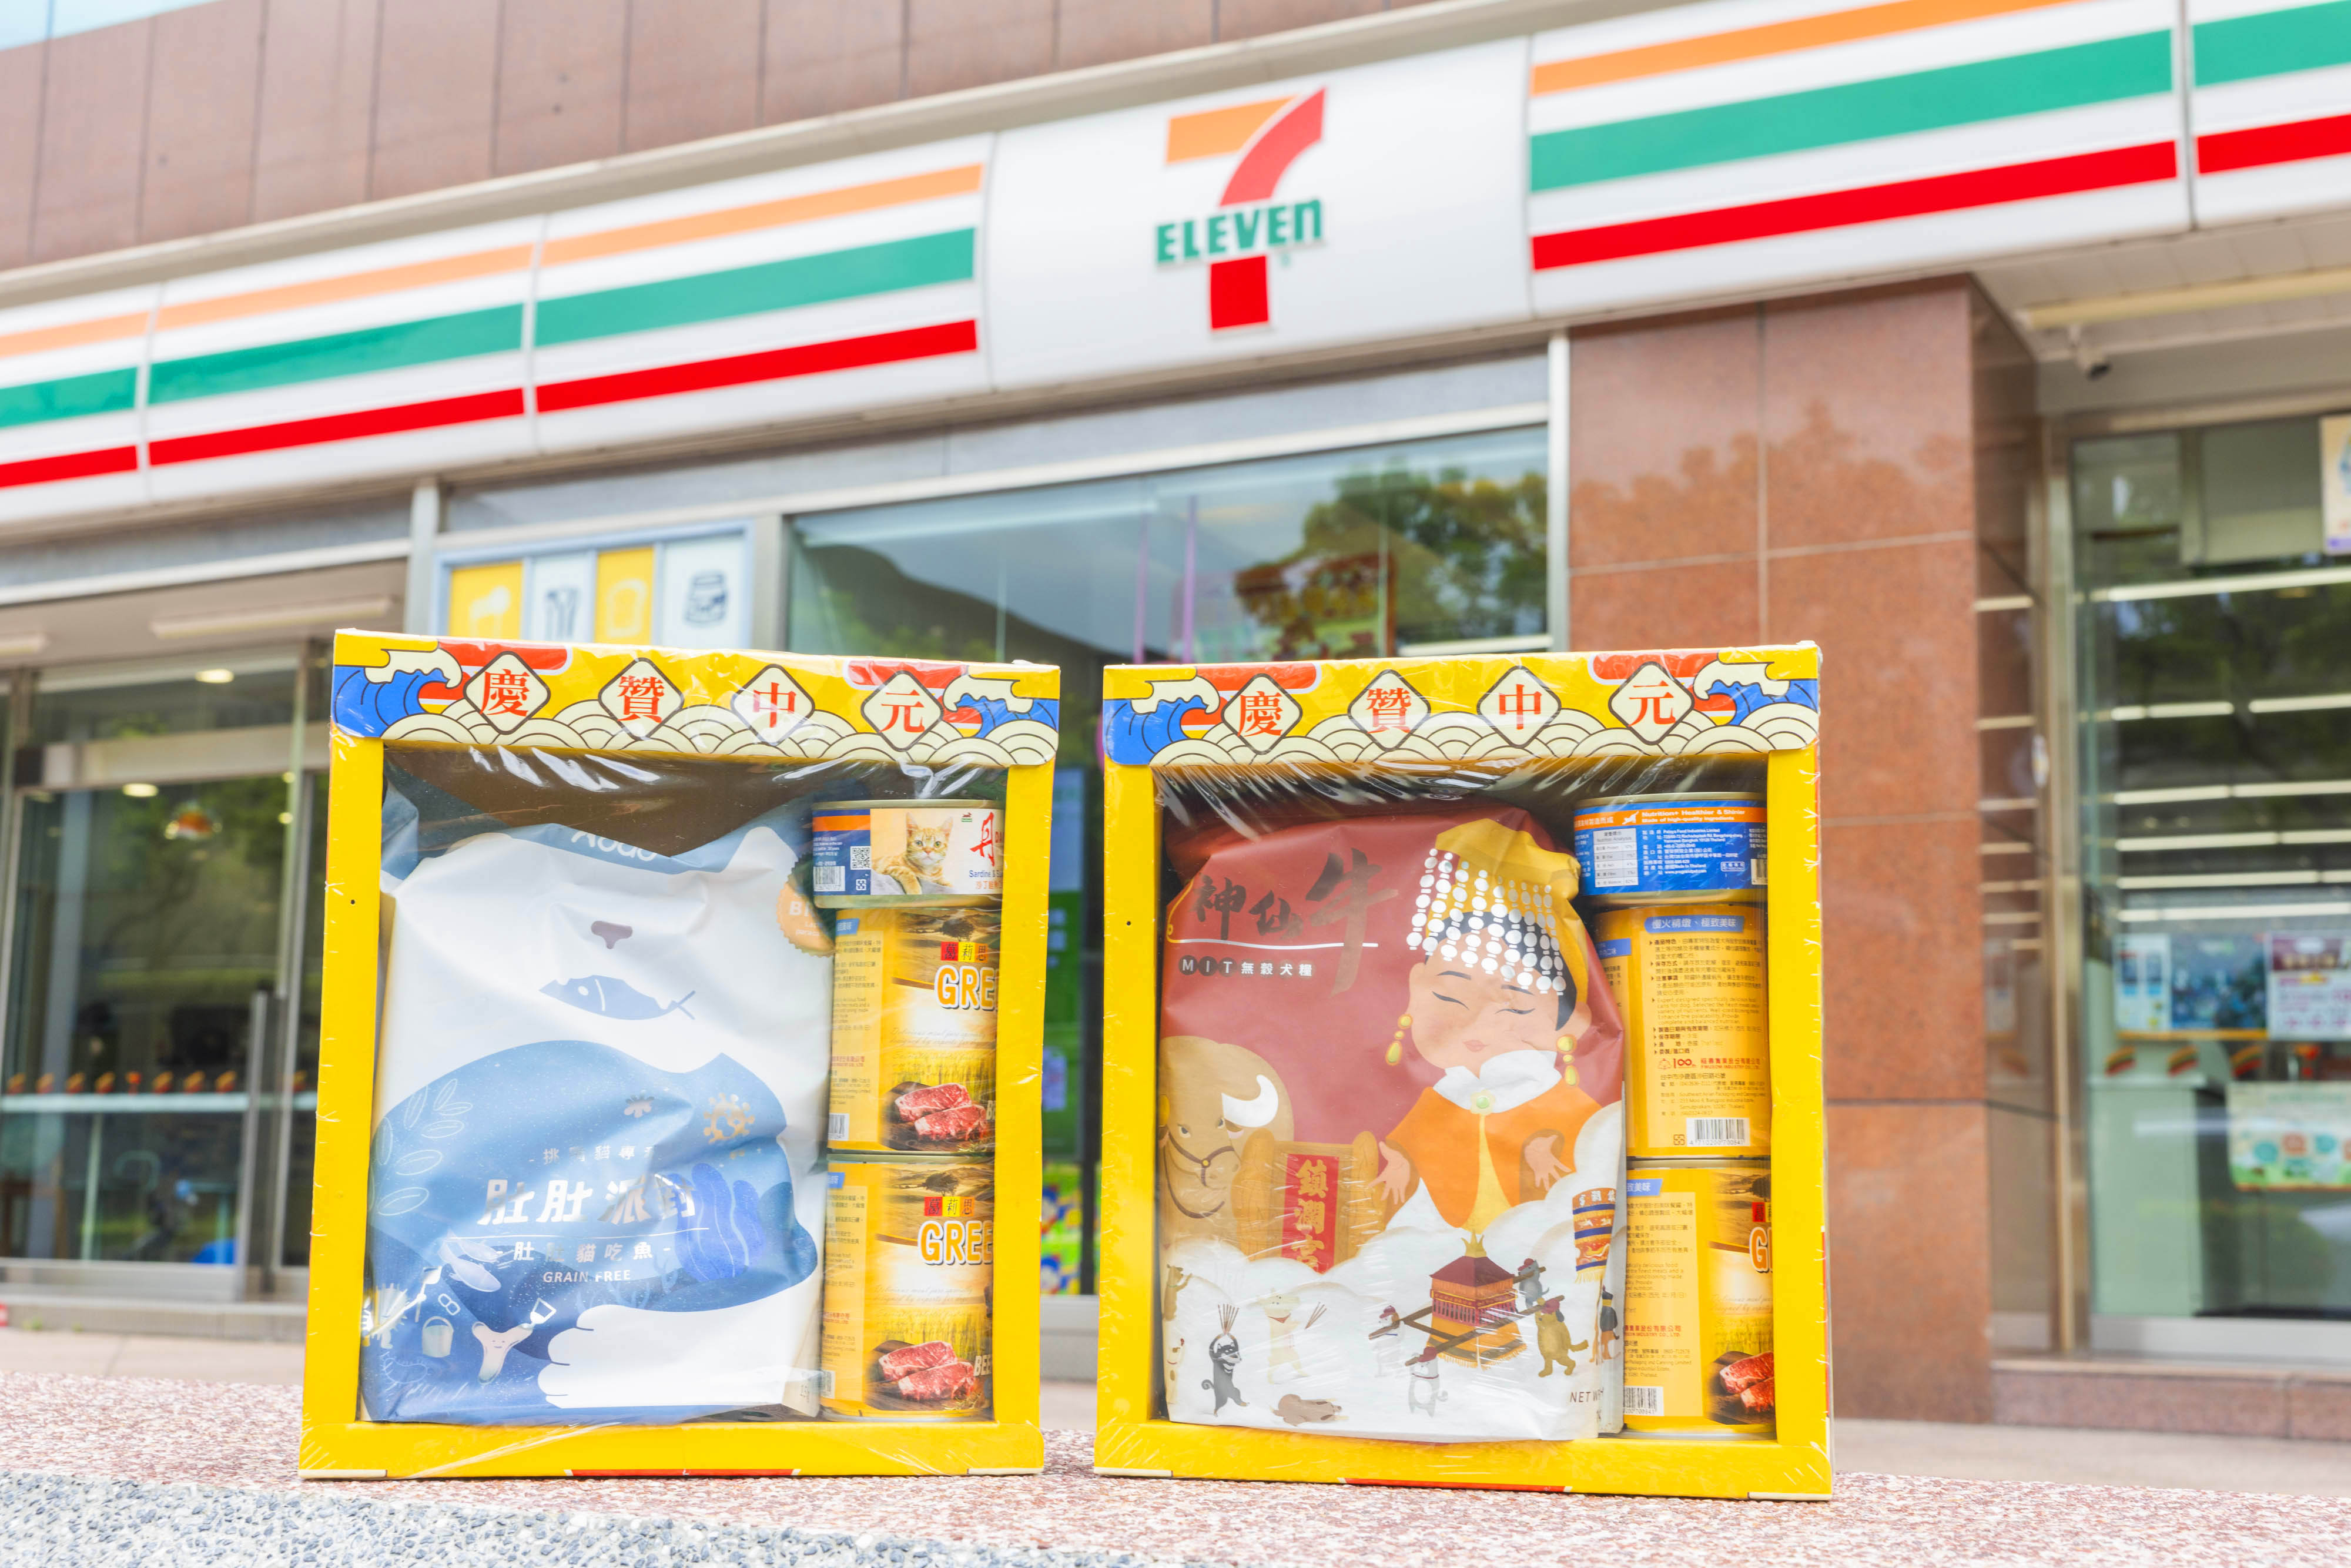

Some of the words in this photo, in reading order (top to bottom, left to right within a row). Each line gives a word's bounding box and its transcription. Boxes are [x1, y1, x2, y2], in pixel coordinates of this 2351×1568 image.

[1166, 85, 1327, 330] 7
[935, 964, 999, 1010] GRE
[542, 1271, 588, 1284] GRAIN
[595, 1269, 631, 1282] FREE
[1569, 1391, 1591, 1403] NET
